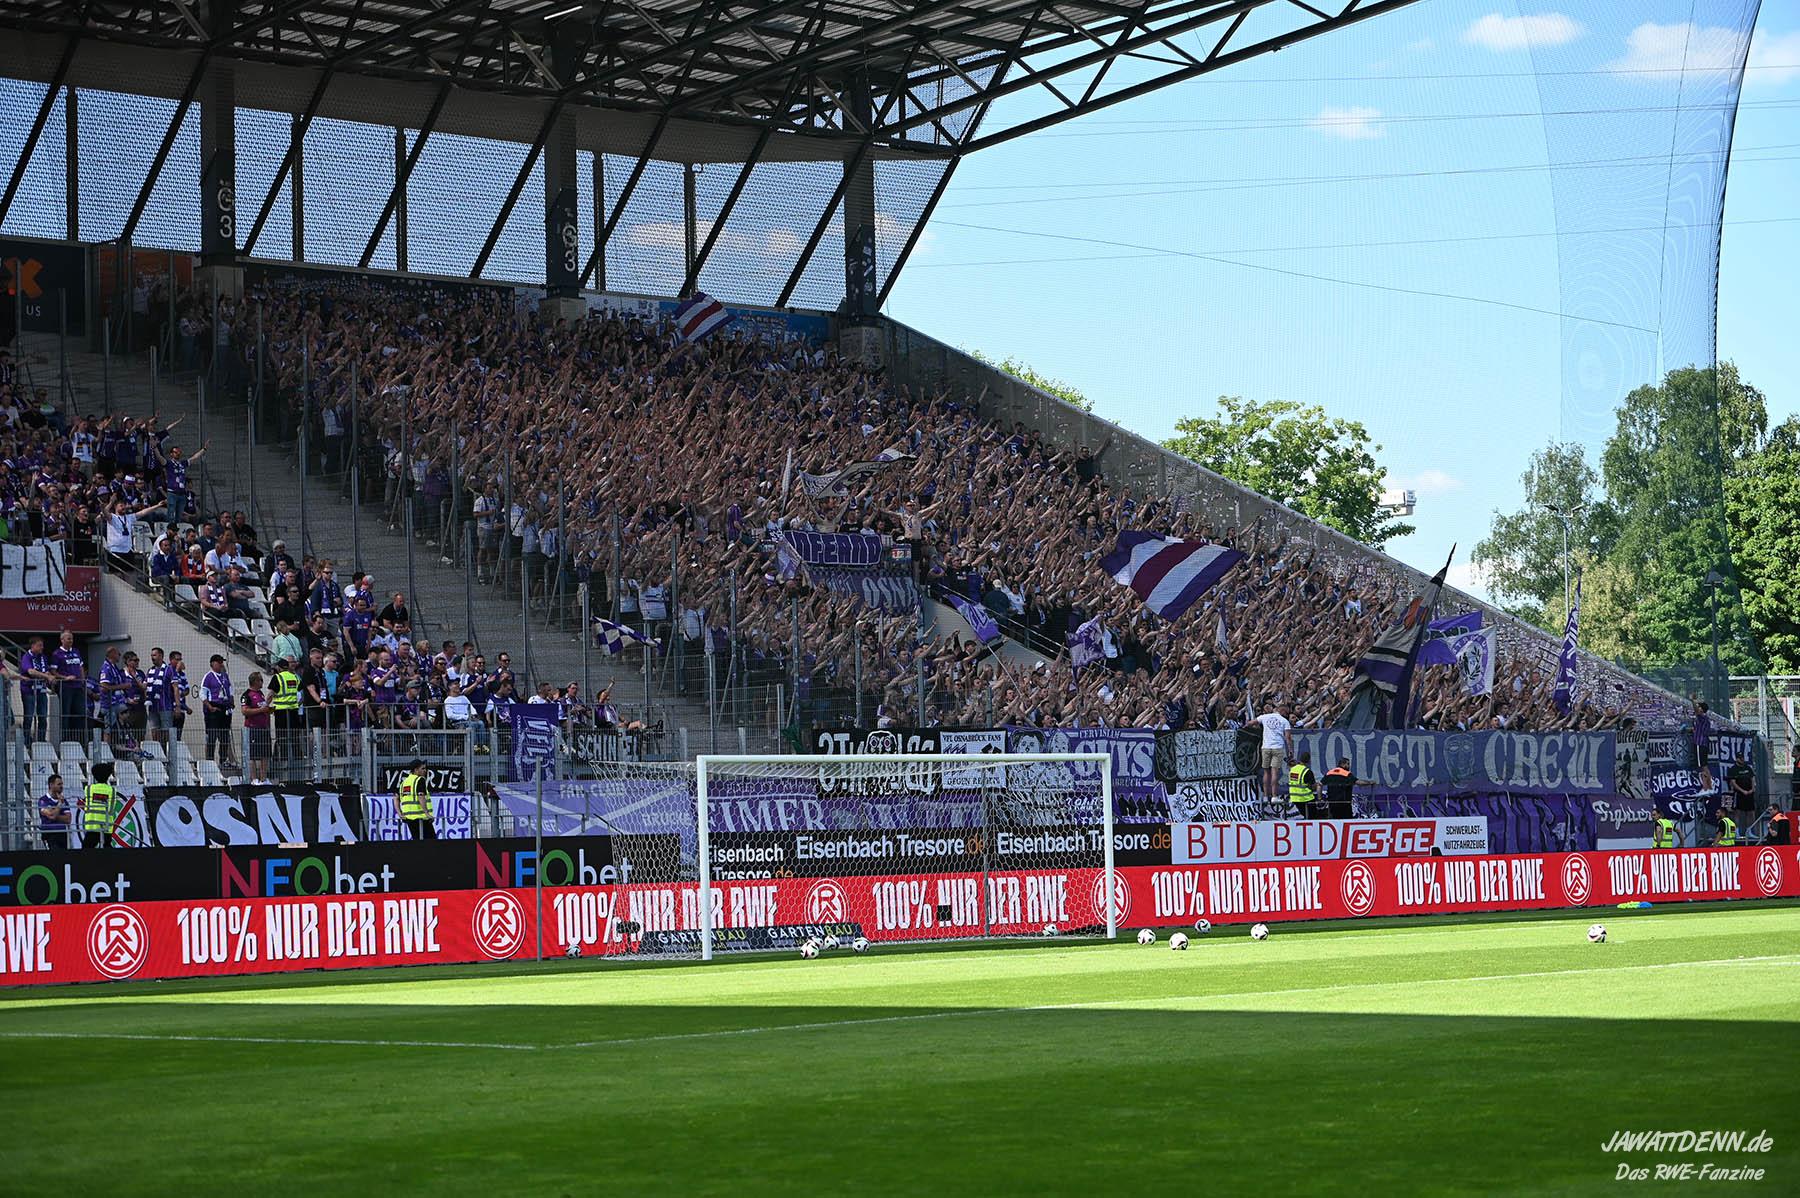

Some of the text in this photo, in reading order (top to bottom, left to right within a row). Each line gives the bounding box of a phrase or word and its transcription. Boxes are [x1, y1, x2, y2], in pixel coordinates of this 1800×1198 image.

[27, 602, 39, 611] Wir
[41, 602, 57, 611] sind
[1483, 731, 1605, 790] CREW
[155, 791, 359, 848] OSNA
[1187, 821, 1338, 860] BTD BTD
[1446, 825, 1483, 836] SCHWERLAST-
[796, 834, 894, 860] Eisenbach
[997, 830, 1087, 855] Eisenbach
[1443, 839, 1486, 851] NUTZFAHRZEUGE
[1151, 865, 1322, 917] 100% NUR DER RWE
[1395, 857, 1546, 906] 100% NUR DER RWE
[1607, 851, 1742, 896] 100% NUR DER RWE
[553, 891, 624, 946] 100%
[730, 885, 778, 928] RWE
[872, 874, 1069, 930] 100% NUR DER RWE
[177, 898, 442, 965] 100% NUR DER RWE
[767, 924, 852, 939] GARTENBAU
